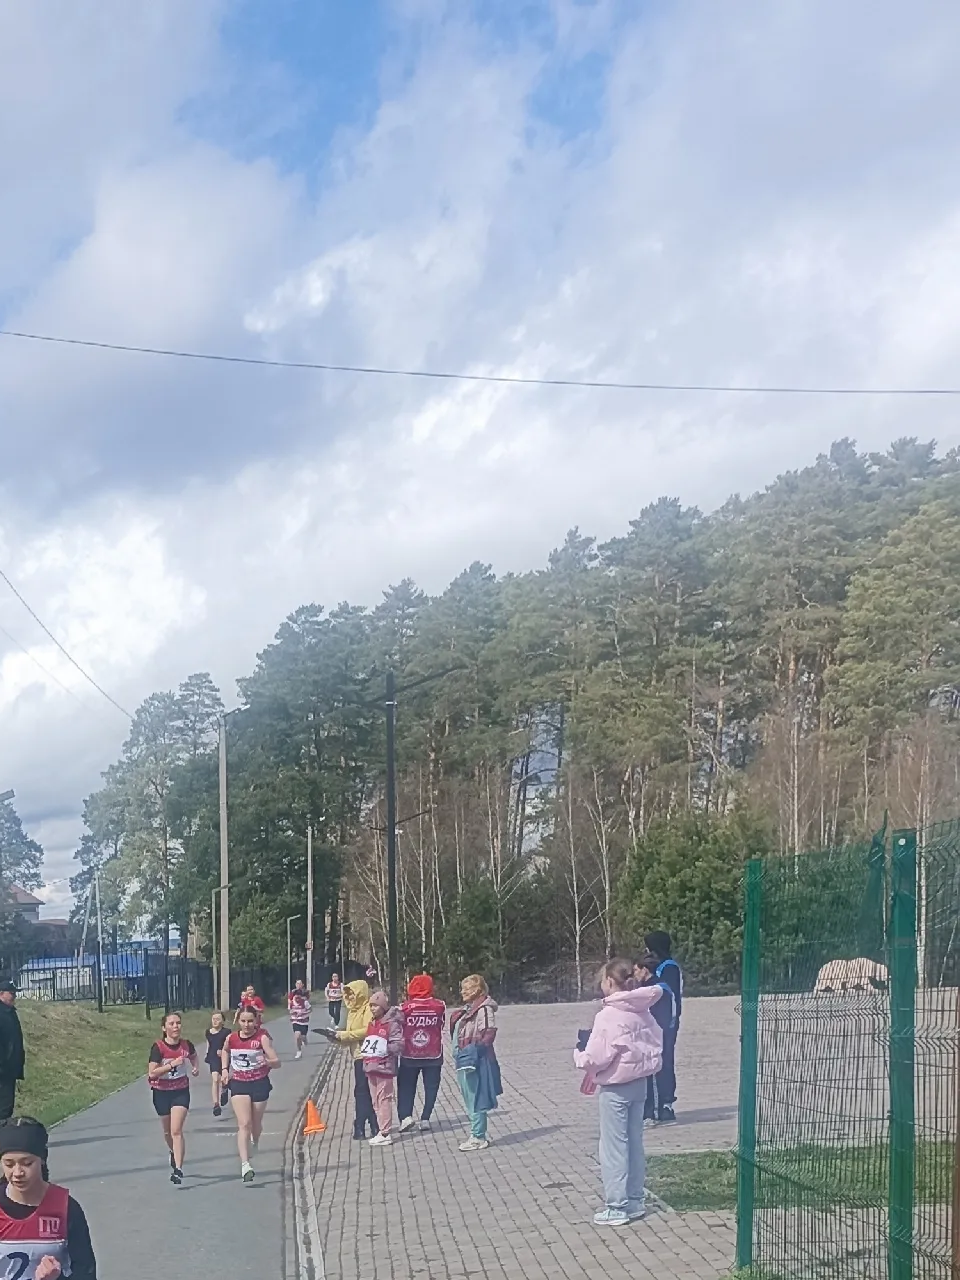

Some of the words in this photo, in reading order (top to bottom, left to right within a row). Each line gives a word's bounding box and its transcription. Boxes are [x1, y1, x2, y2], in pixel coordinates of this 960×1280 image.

[406, 1016, 438, 1027] СУДЬЯ
[361, 1039, 379, 1054] 24
[238, 1053, 251, 1068] 3
